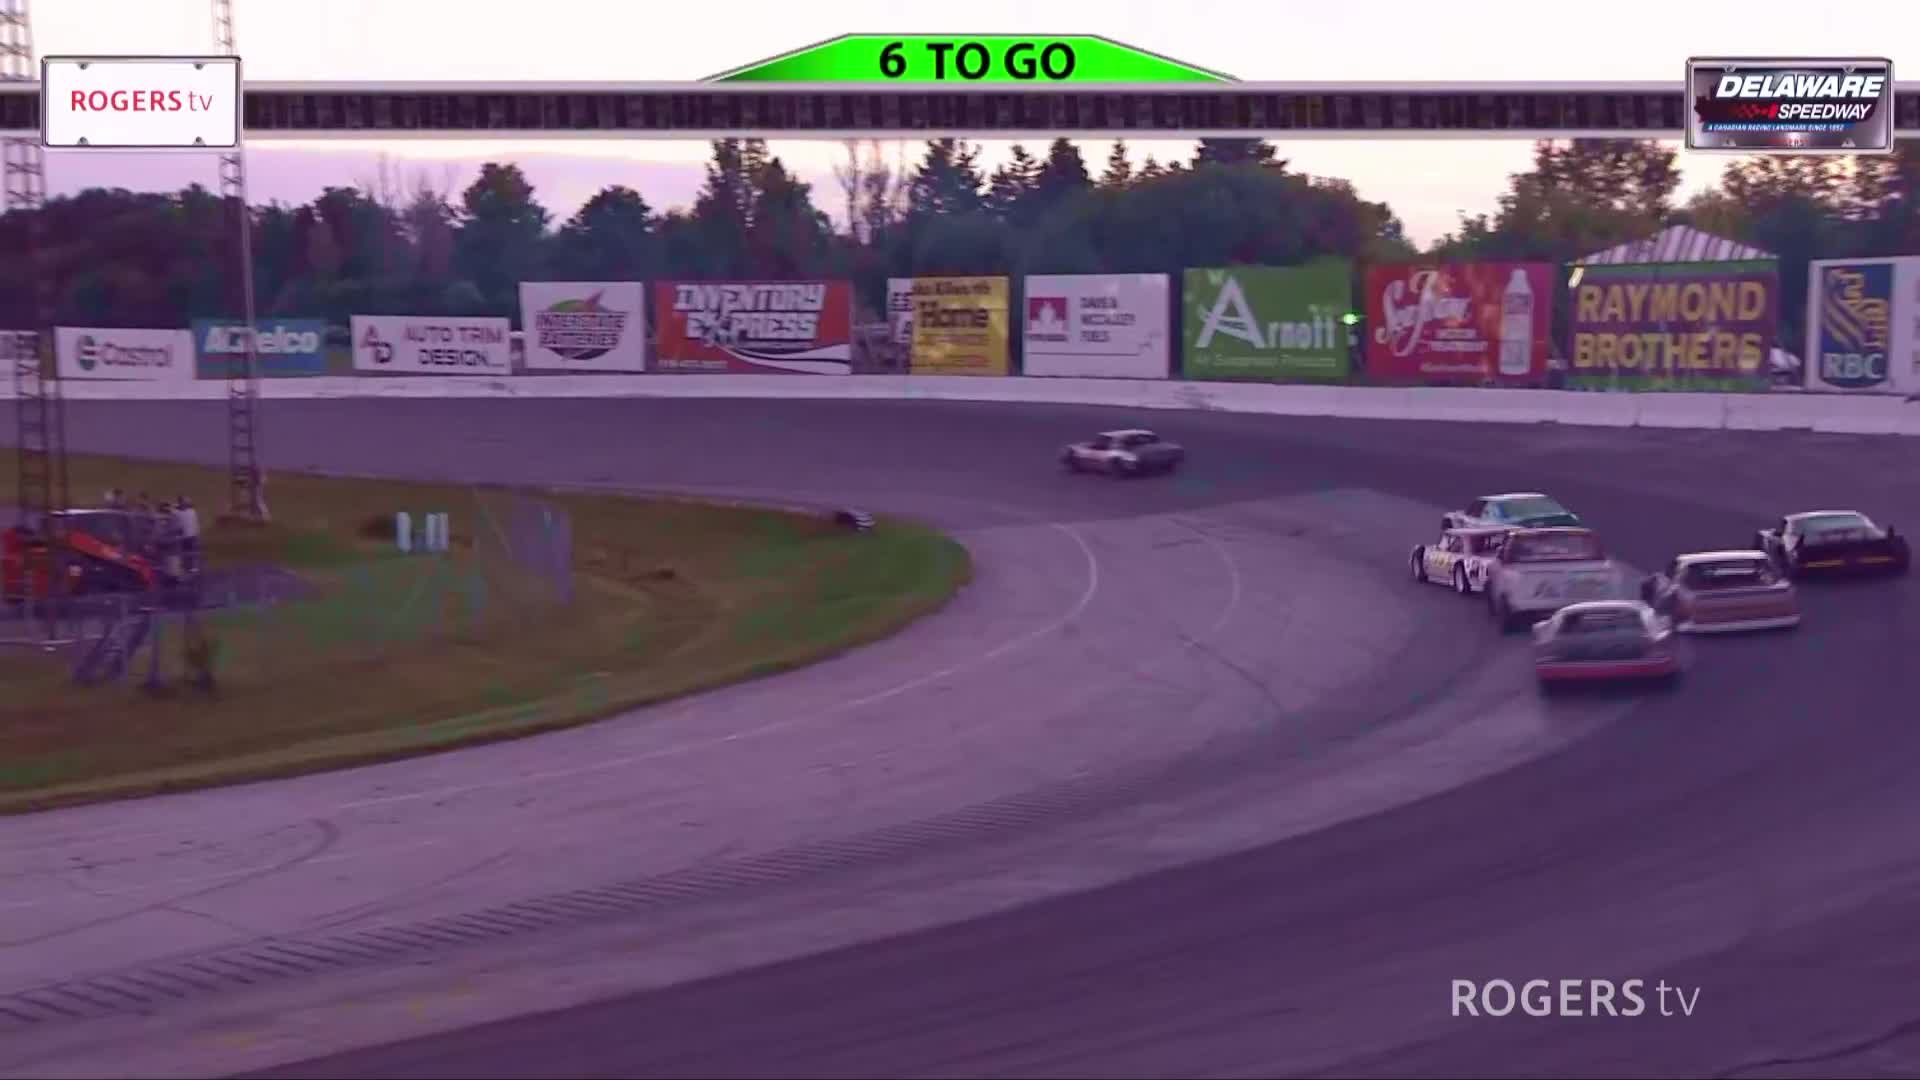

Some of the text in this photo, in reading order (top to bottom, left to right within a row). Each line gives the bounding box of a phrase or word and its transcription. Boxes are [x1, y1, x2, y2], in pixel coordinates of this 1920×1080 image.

[1194, 273, 1336, 350] Arnott
[1575, 281, 1766, 323] RAYMOND
[406, 325, 453, 344] AUTO
[1573, 333, 1763, 369] BROTHERS
[1823, 353, 1885, 379] RBC
